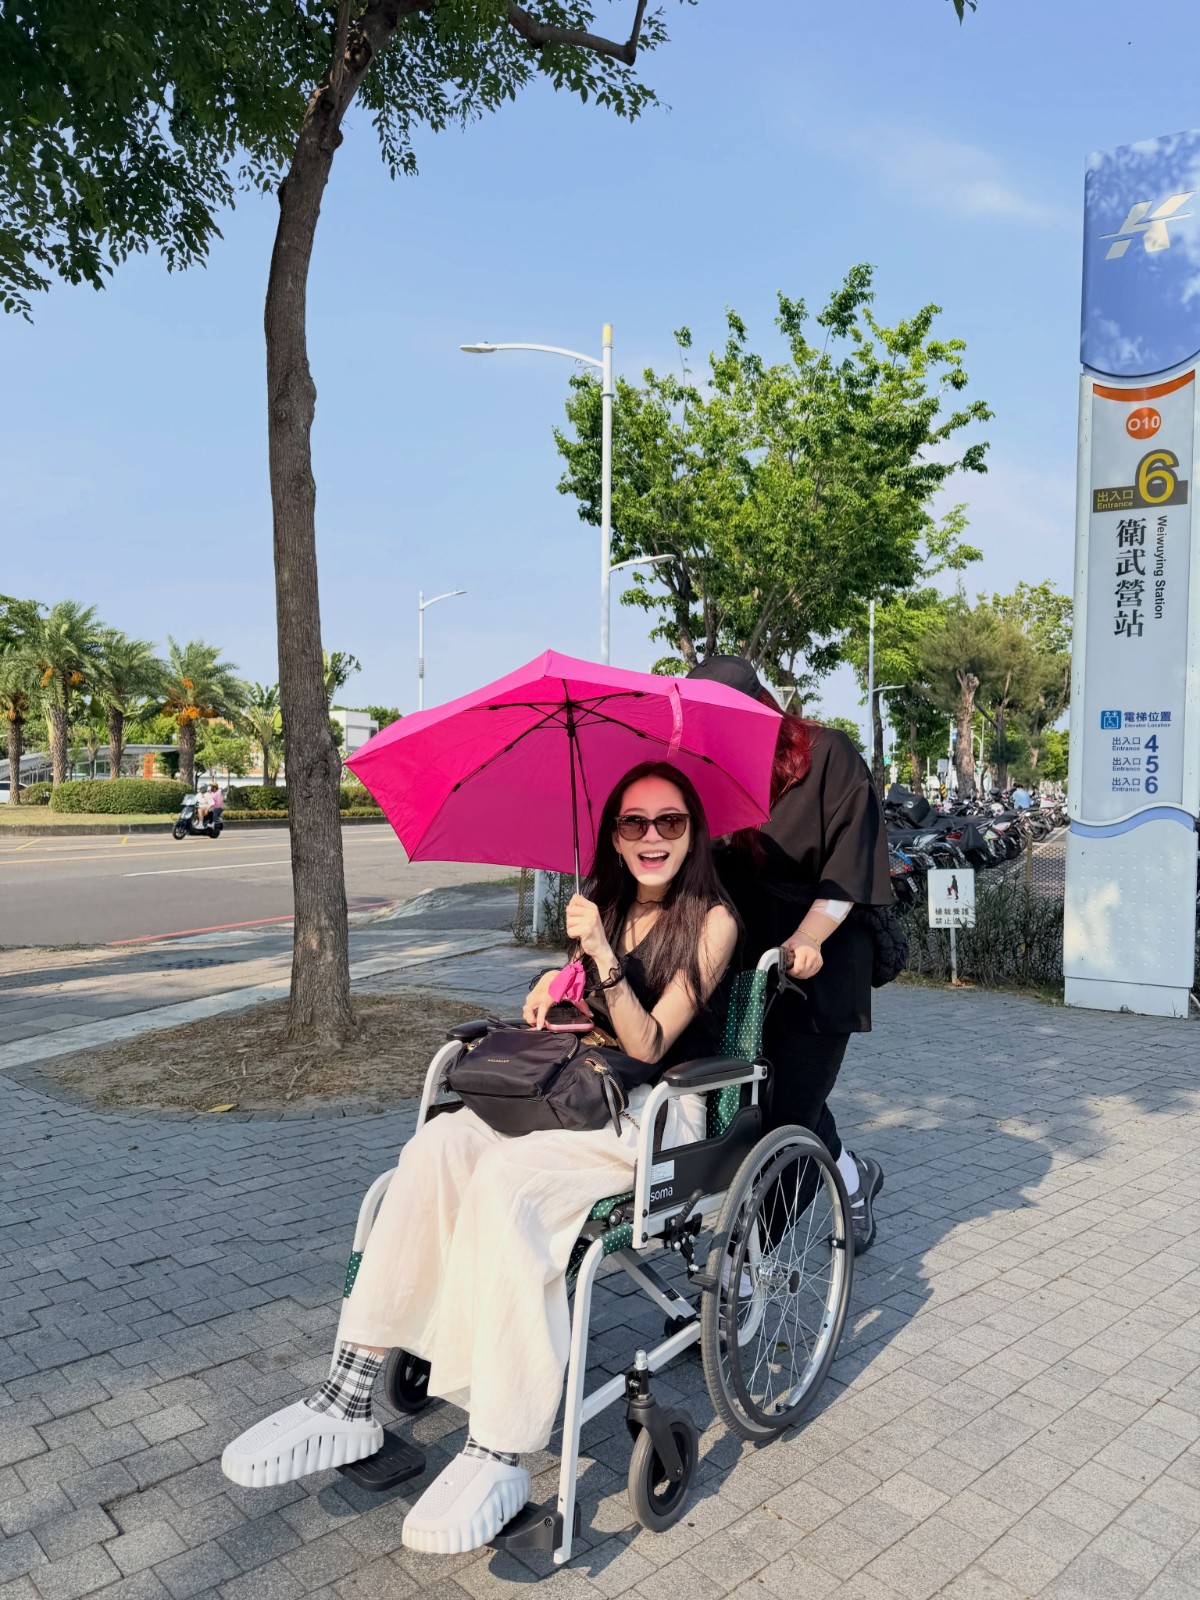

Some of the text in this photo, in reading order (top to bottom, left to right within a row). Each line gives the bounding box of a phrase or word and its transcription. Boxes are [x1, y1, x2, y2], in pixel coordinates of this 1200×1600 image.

[1127, 415, 1161, 432] O10
[1138, 452, 1175, 504] 6
[1097, 489, 1134, 503] 出入口
[1097, 500, 1133, 510] Entrance
[1153, 515, 1168, 619] Weiwuying Station
[1113, 517, 1147, 638] 衛武營站
[1124, 711, 1172, 722] 電梯位置
[1112, 734, 1159, 753] 出入口 4
[1112, 755, 1159, 774] 出入口 5
[1112, 775, 1158, 794] 出入口 6
